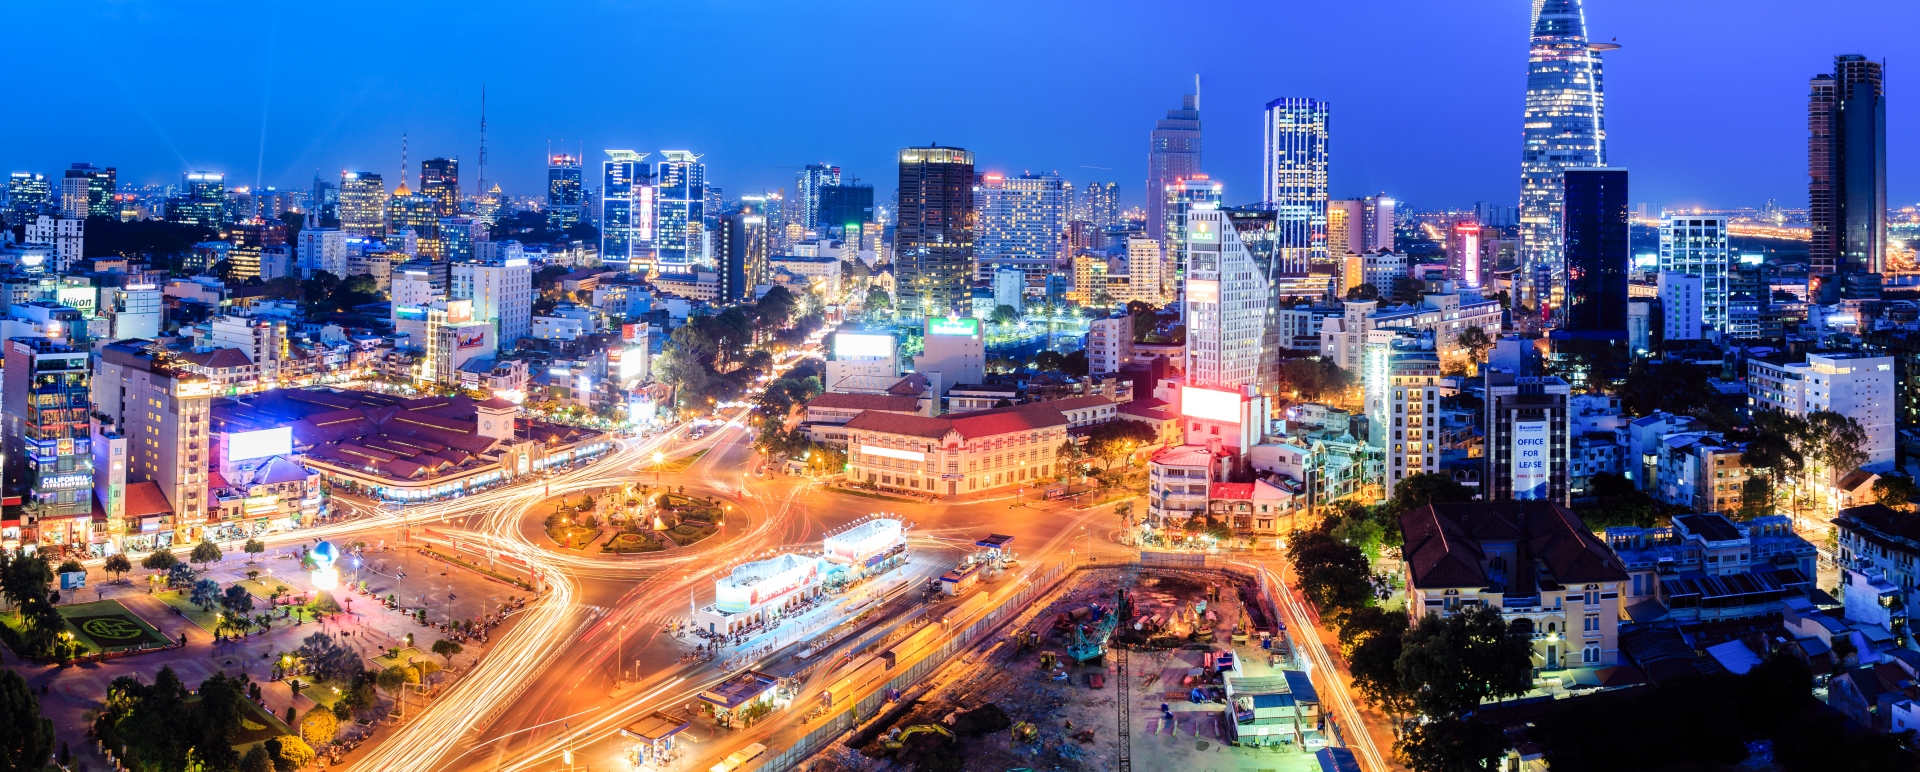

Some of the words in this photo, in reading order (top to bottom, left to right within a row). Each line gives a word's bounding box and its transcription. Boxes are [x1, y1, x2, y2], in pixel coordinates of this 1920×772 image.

[62, 297, 92, 307] Nikon
[1517, 438, 1544, 446] OFFICE
[1519, 460, 1542, 469] LEASE
[43, 475, 88, 484] CALIFORNIA
